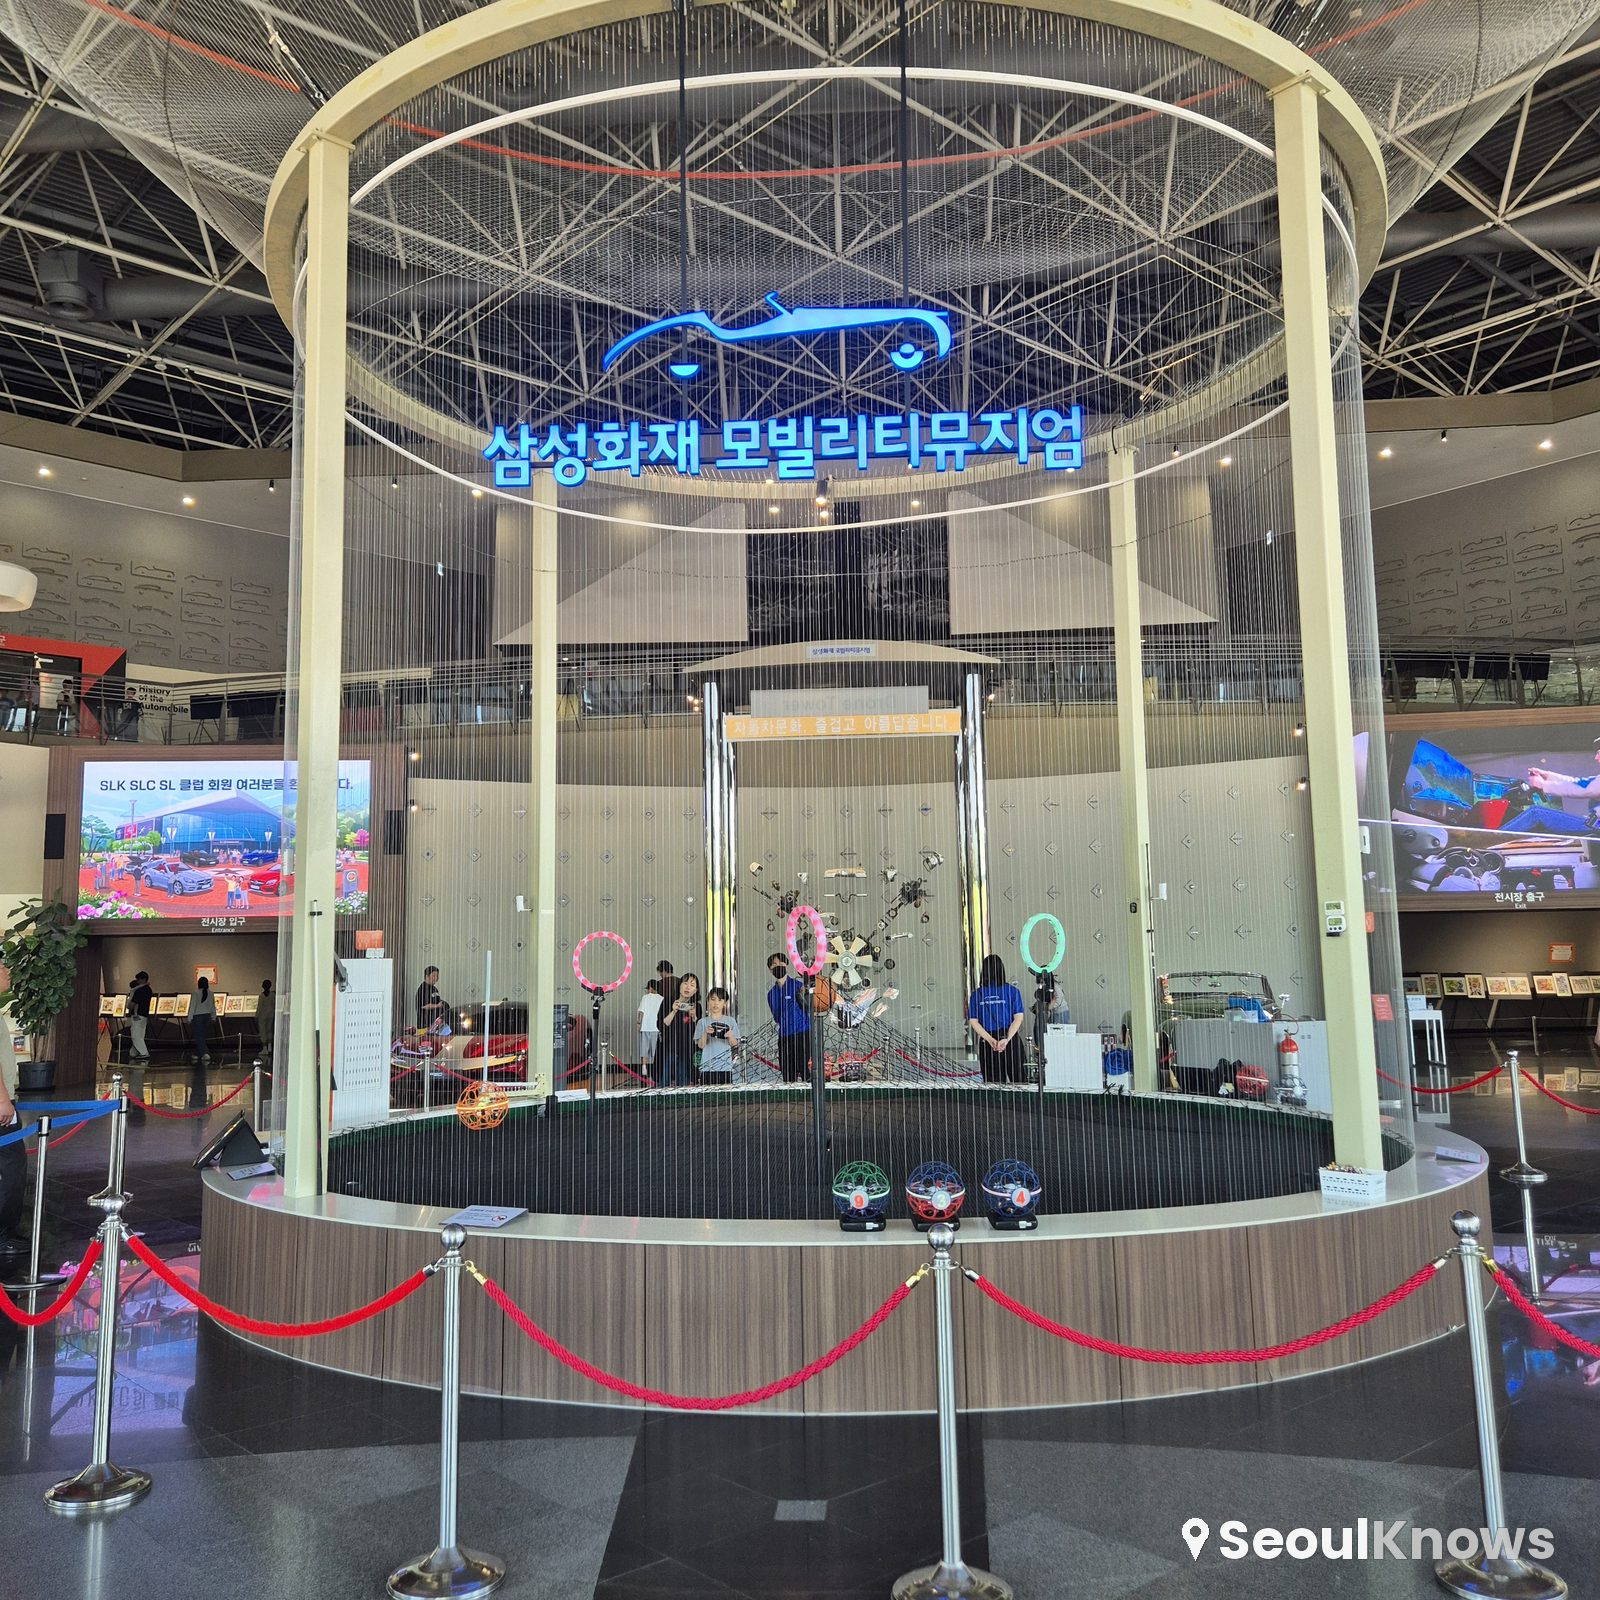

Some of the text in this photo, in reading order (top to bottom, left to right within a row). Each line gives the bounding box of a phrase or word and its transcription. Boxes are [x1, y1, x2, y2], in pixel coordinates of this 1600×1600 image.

[482, 405, 1084, 487] 삼성화재 모빌리티뮤지엄
[139, 685, 171, 697] History
[139, 693, 164, 703] of the
[139, 701, 189, 714] Automobile
[100, 780, 126, 791] SLK
[130, 779, 156, 791] SLC
[159, 779, 176, 791] SL
[179, 778, 204, 791] 클럽
[208, 778, 232, 791] 회원
[236, 778, 285, 791] 여러분을
[1494, 891, 1545, 903] 전시장 출구
[201, 916, 246, 927] 전시장 입구
[1015, 1190, 1025, 1205] 4
